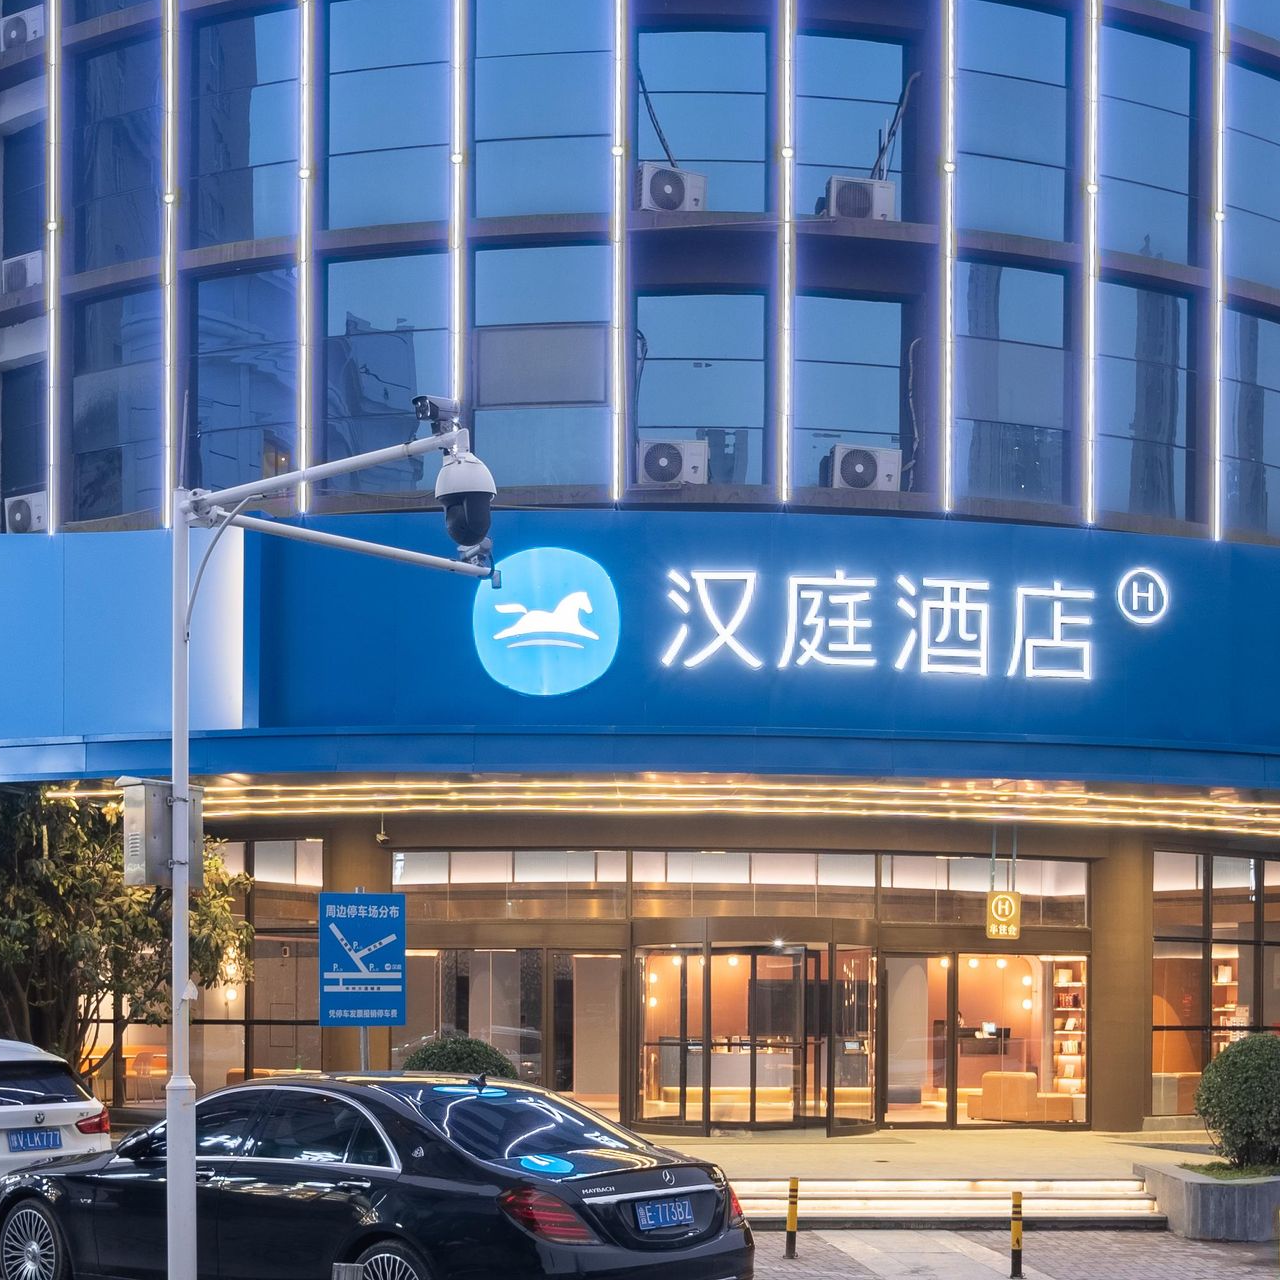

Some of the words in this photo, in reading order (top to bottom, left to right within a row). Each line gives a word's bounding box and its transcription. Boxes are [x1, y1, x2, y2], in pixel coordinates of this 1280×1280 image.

[661, 568, 1095, 680] 汉庭酒店
[325, 904, 399, 918] 周边停车场分布
[989, 923, 1017, 936] 华住会
[328, 1009, 398, 1018] 凭停车发票报销停车费
[581, 1186, 615, 1195] MAYBACH
